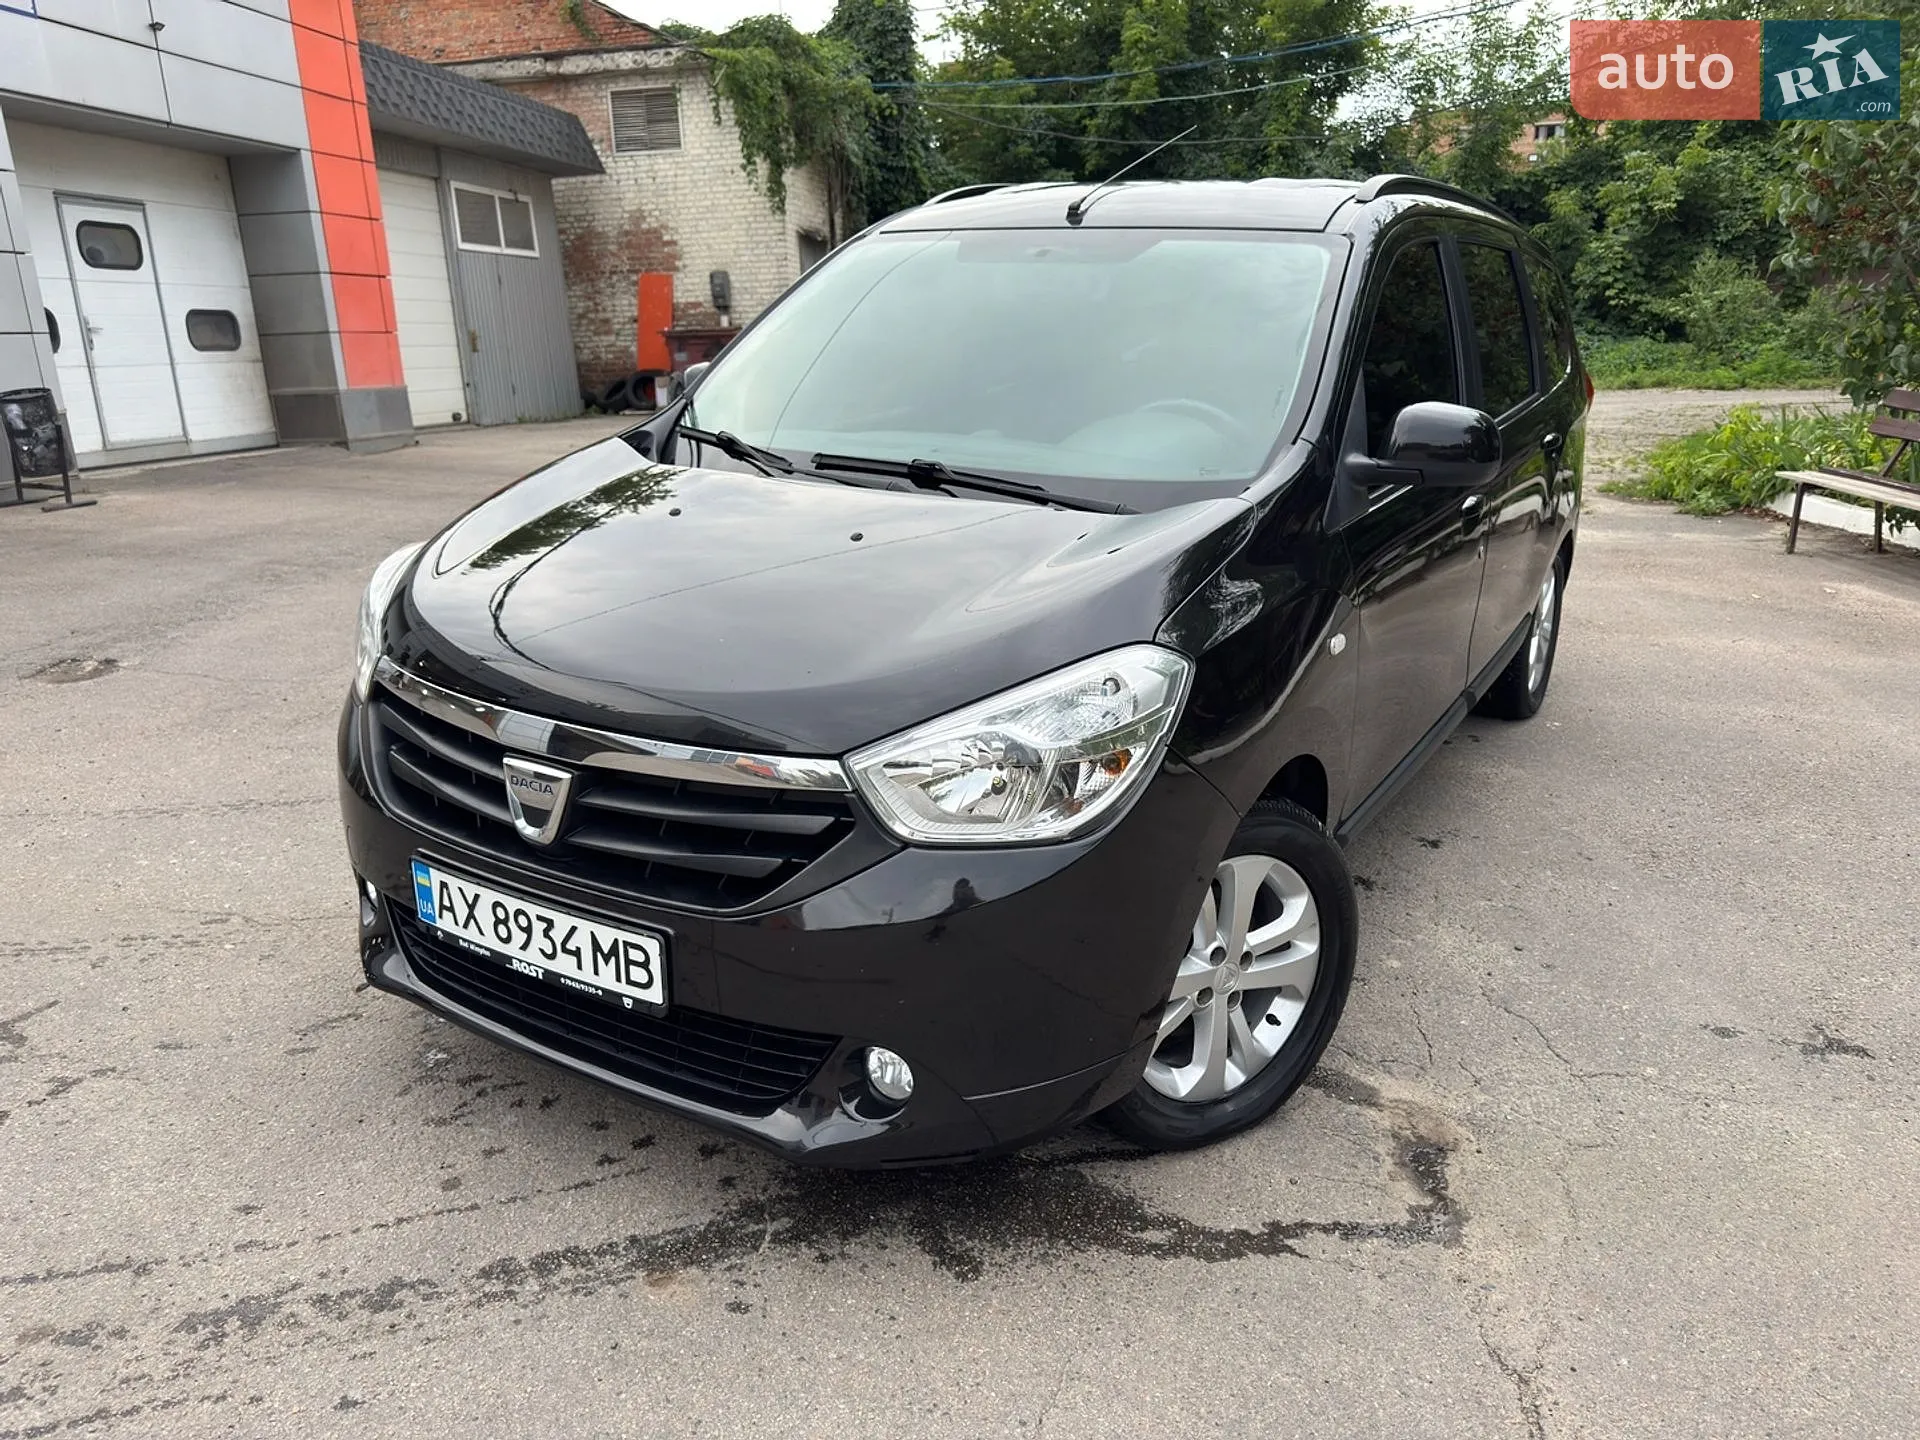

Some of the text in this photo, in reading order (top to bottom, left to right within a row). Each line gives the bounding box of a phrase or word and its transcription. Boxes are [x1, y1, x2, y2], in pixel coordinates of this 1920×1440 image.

[510, 774, 554, 796] DACIA
[419, 900, 436, 916] UA
[438, 880, 655, 990] AX 8934 MB
[511, 957, 545, 980] ROST
